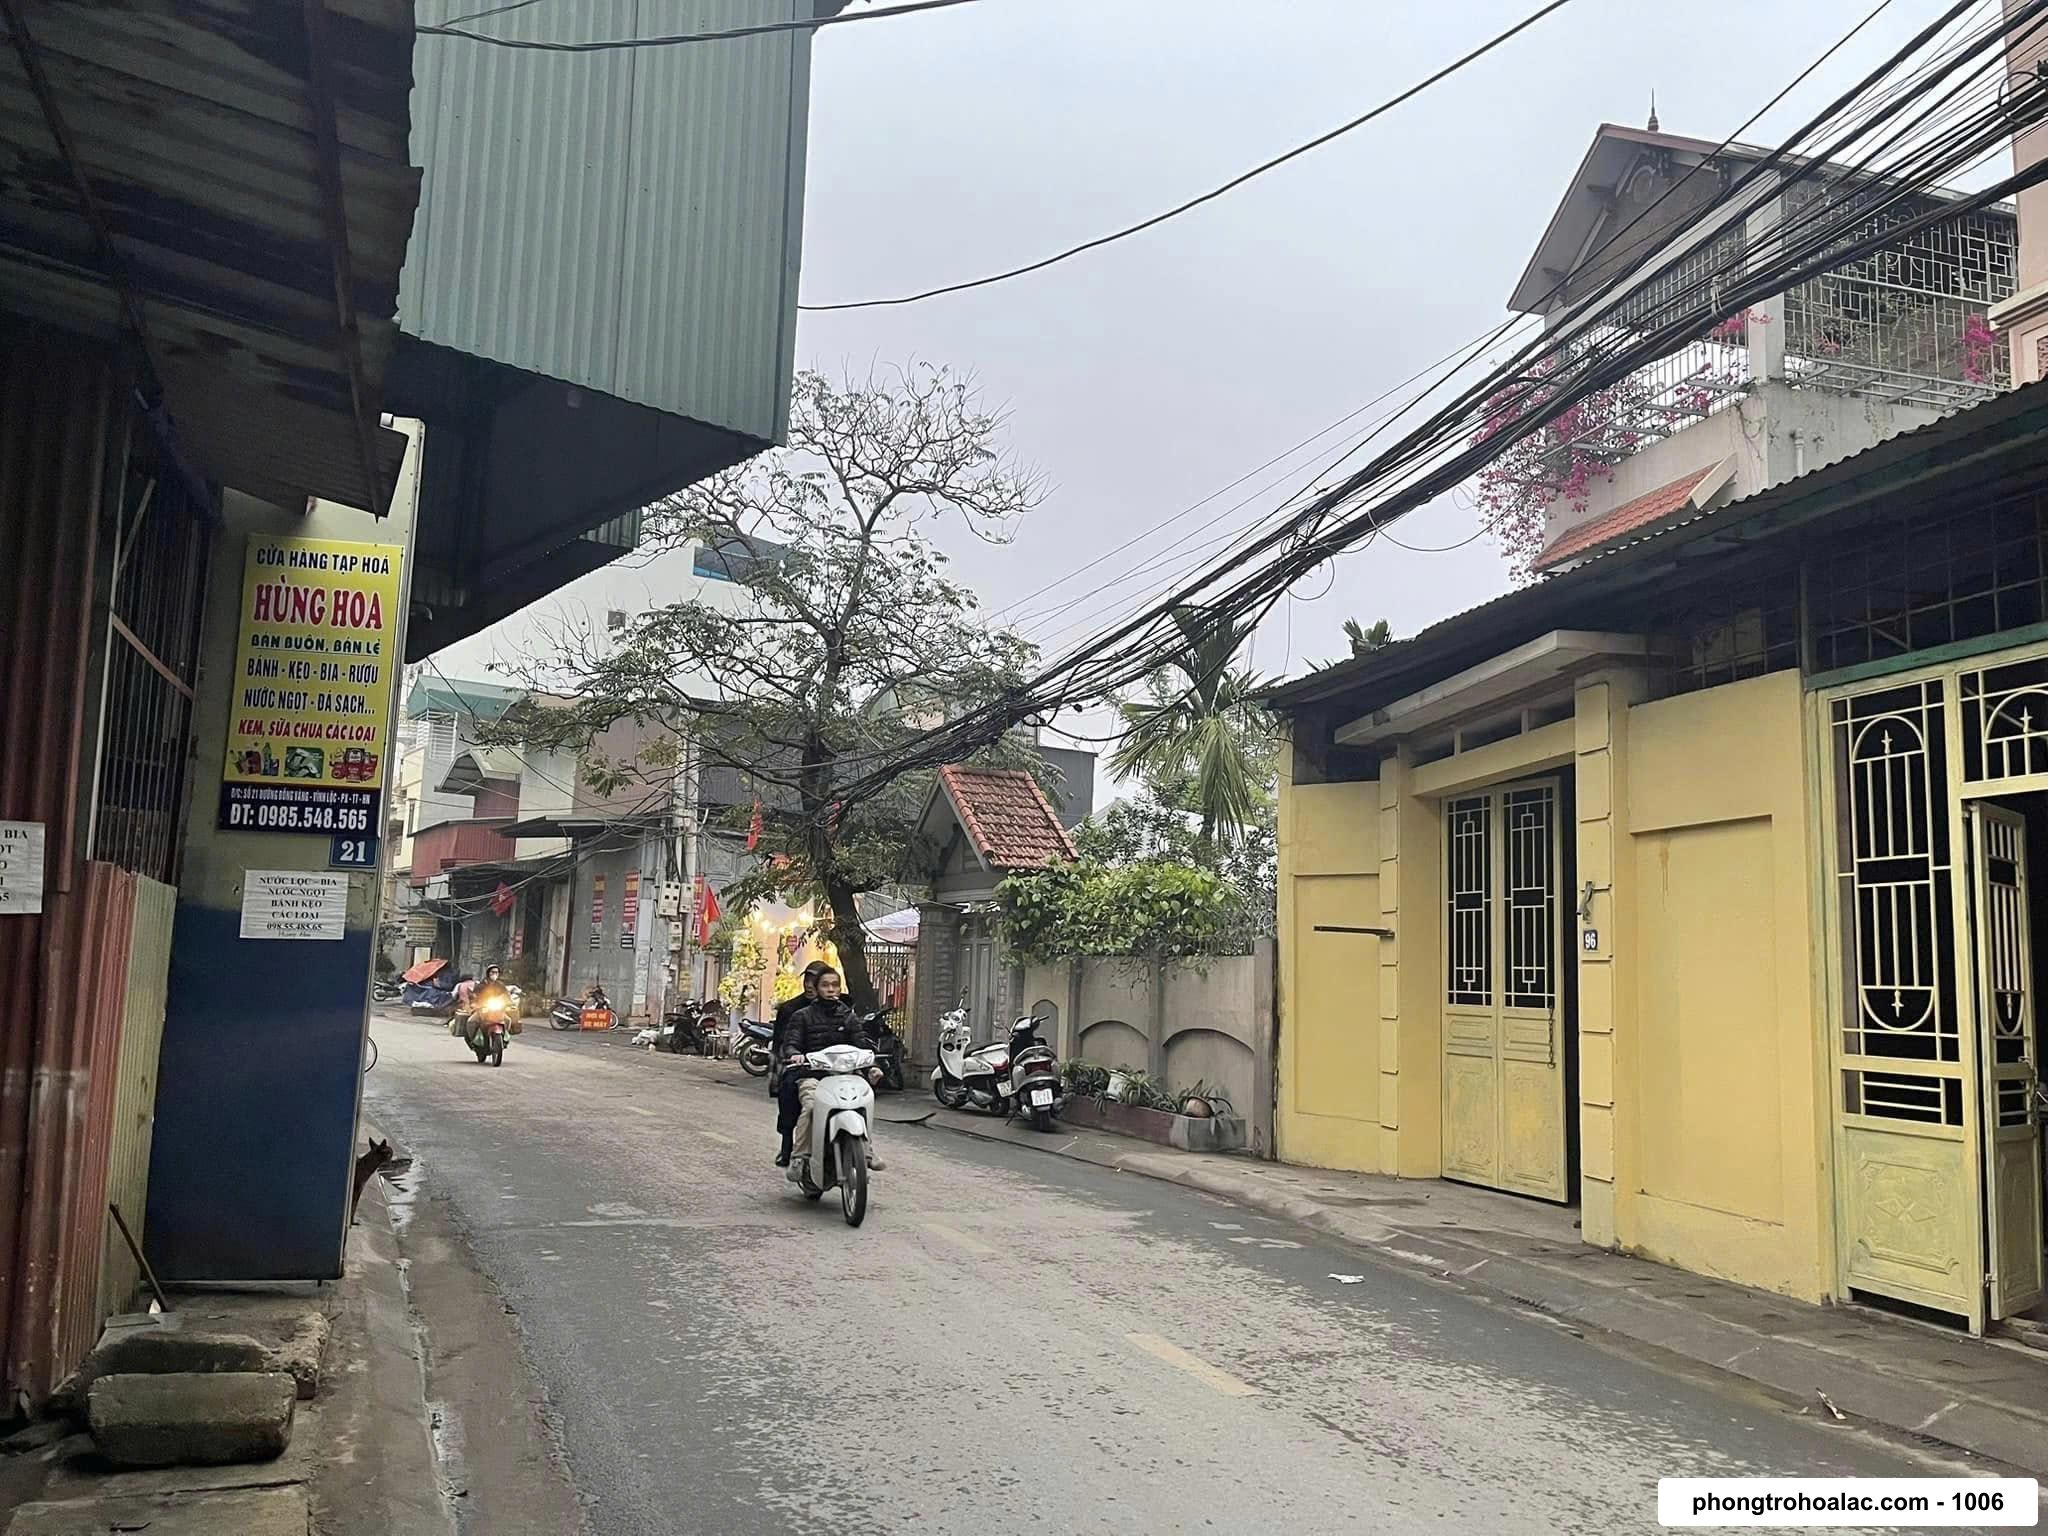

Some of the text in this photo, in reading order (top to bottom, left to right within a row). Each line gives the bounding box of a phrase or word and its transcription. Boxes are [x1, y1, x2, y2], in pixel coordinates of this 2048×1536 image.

[257, 544, 389, 575] CỬA HÀNG TẠP HOÁ
[254, 574, 383, 629] HÙNG HOA
[251, 632, 381, 654] BÁN BUÔN, BÁN LẺ
[247, 655, 278, 677] BÁNH
[288, 660, 310, 683] KẸO
[320, 662, 339, 681] BIA
[349, 664, 379, 687] RƯỢU
[244, 686, 275, 708] NƯỚC
[278, 691, 308, 714] NGỌT
[317, 689, 332, 712] ĐÁ
[335, 693, 375, 716] SẠCH...
[238, 717, 376, 745] KEM, SỮA CHUA CÁC LOẠI
[230, 803, 368, 830] ĐT: 0985.548.565
[5, 829, 27, 839] BIA
[340, 840, 366, 862] 21
[1585, 932, 1597, 949] 96
